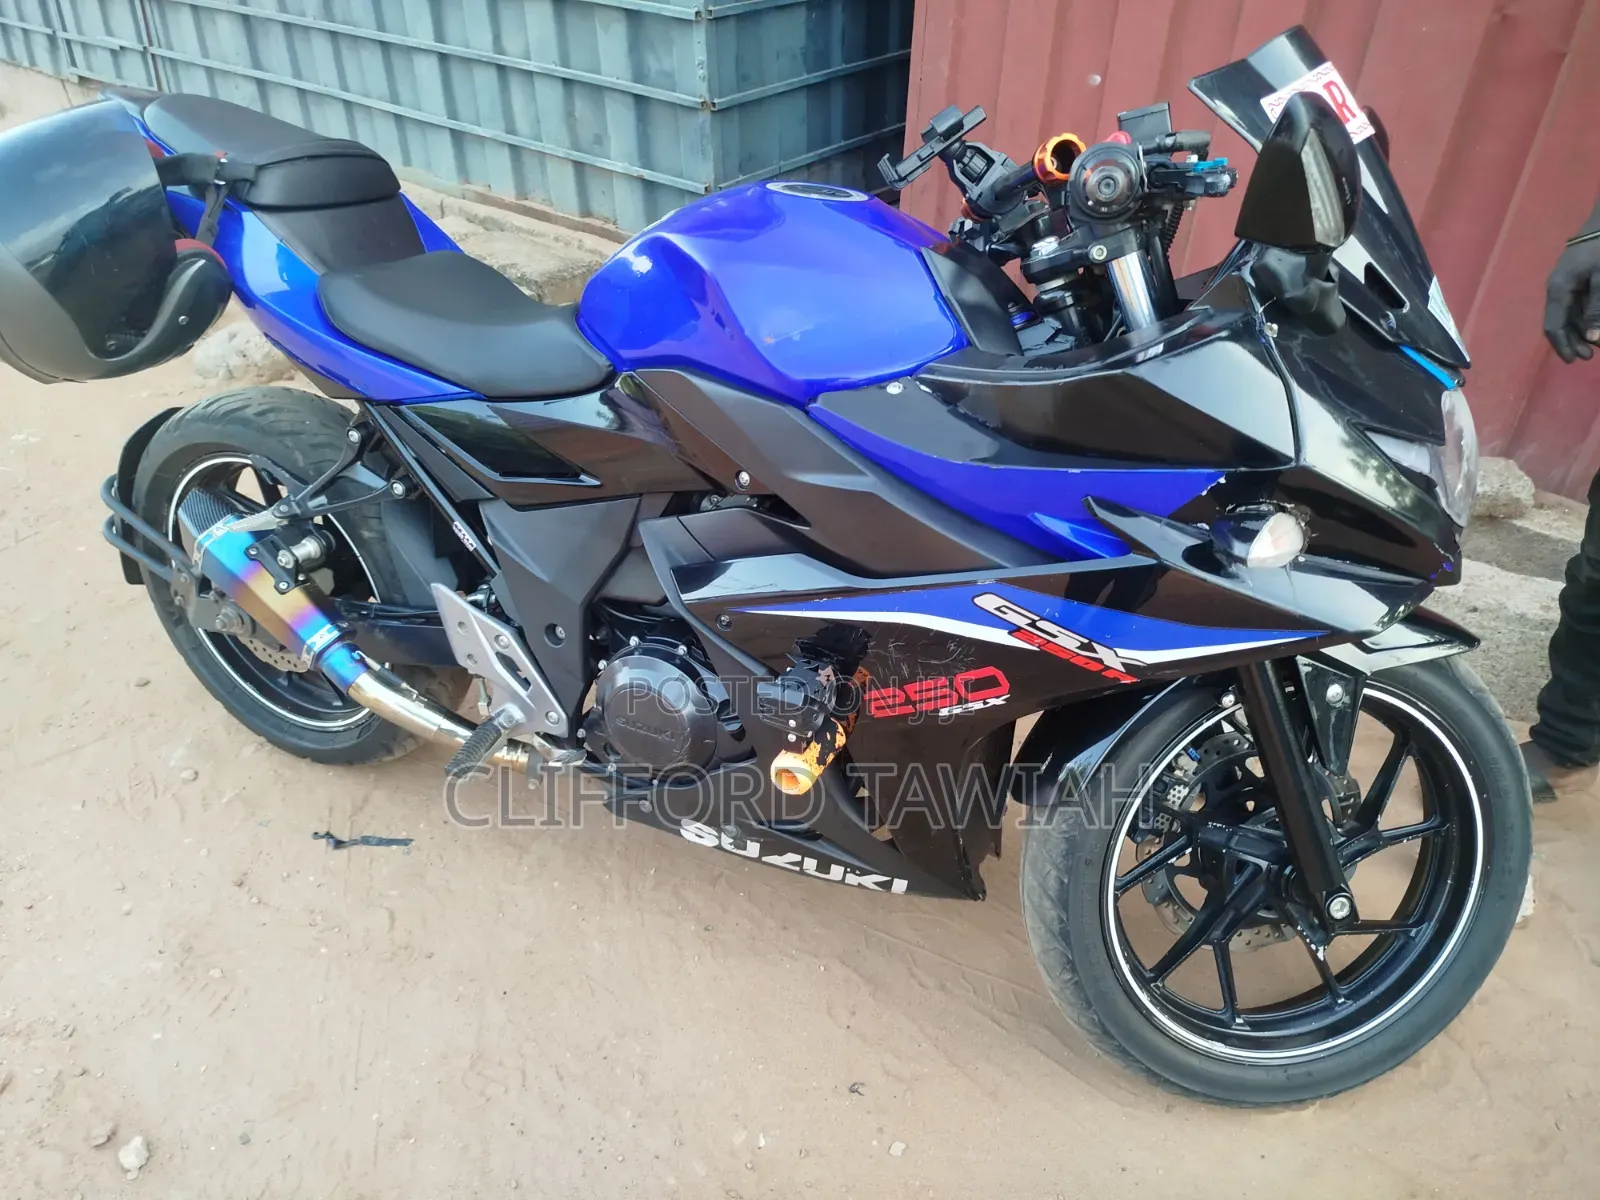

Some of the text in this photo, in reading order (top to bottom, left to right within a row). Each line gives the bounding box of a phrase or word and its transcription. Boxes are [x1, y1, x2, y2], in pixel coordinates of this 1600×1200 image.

[972, 592, 1148, 673] GSX
[864, 666, 1010, 719] 250
[939, 694, 1011, 717] GSX
[680, 818, 909, 895] SUZUKI
